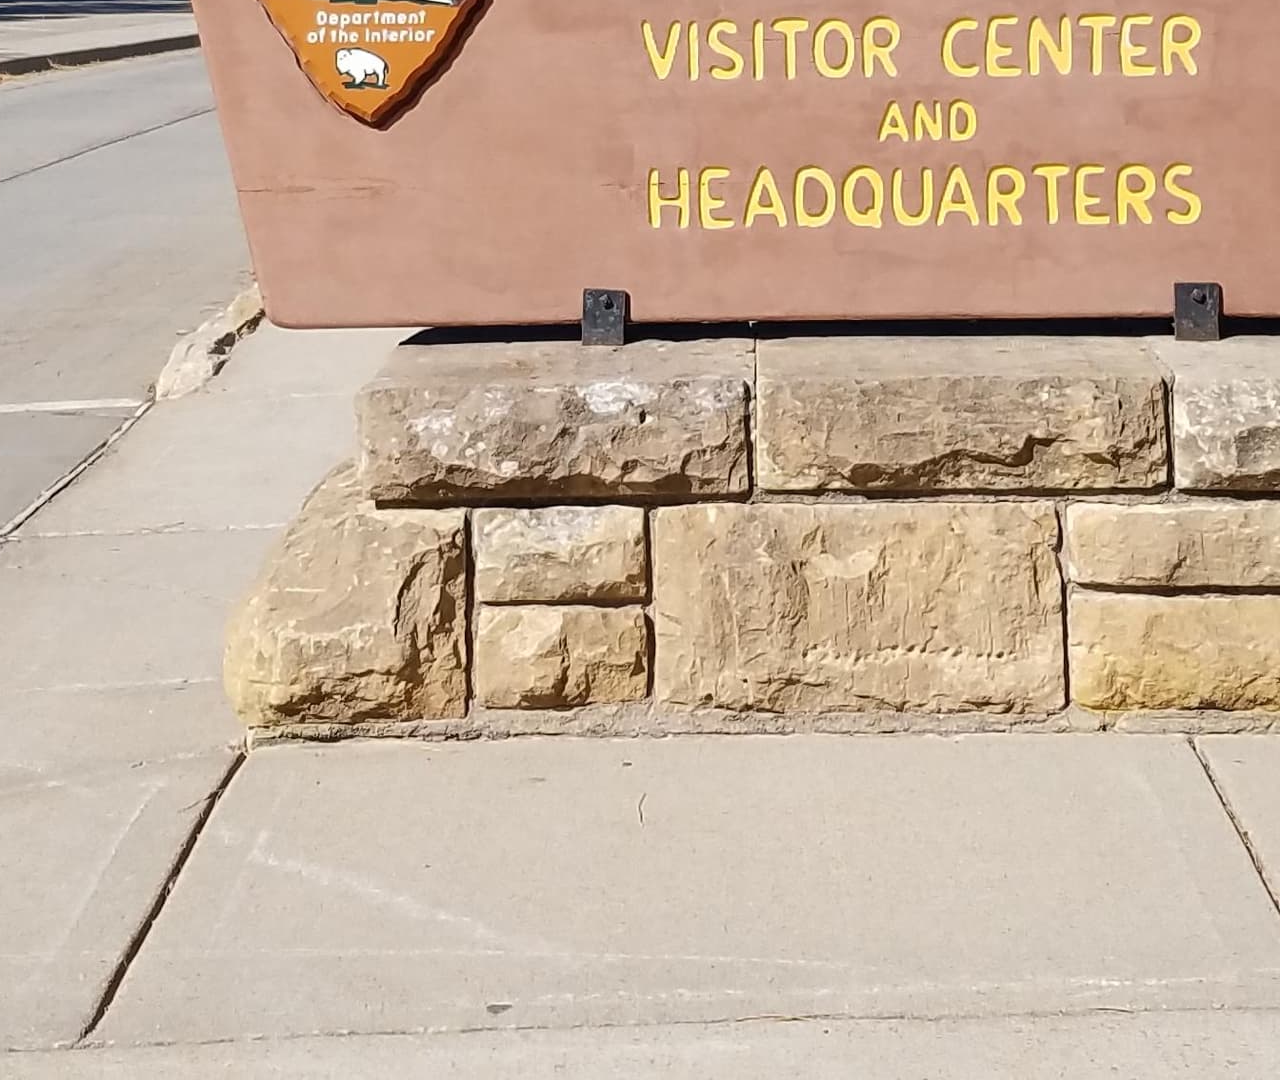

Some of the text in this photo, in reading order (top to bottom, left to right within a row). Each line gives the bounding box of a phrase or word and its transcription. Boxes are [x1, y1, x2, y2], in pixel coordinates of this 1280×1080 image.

[307, 27, 326, 44] of
[330, 28, 360, 43] the
[316, 10, 427, 28] Department
[641, 13, 1202, 81] VISITOR CENTER
[877, 98, 979, 143] AND
[647, 162, 1203, 229] HEADQUARTERS
